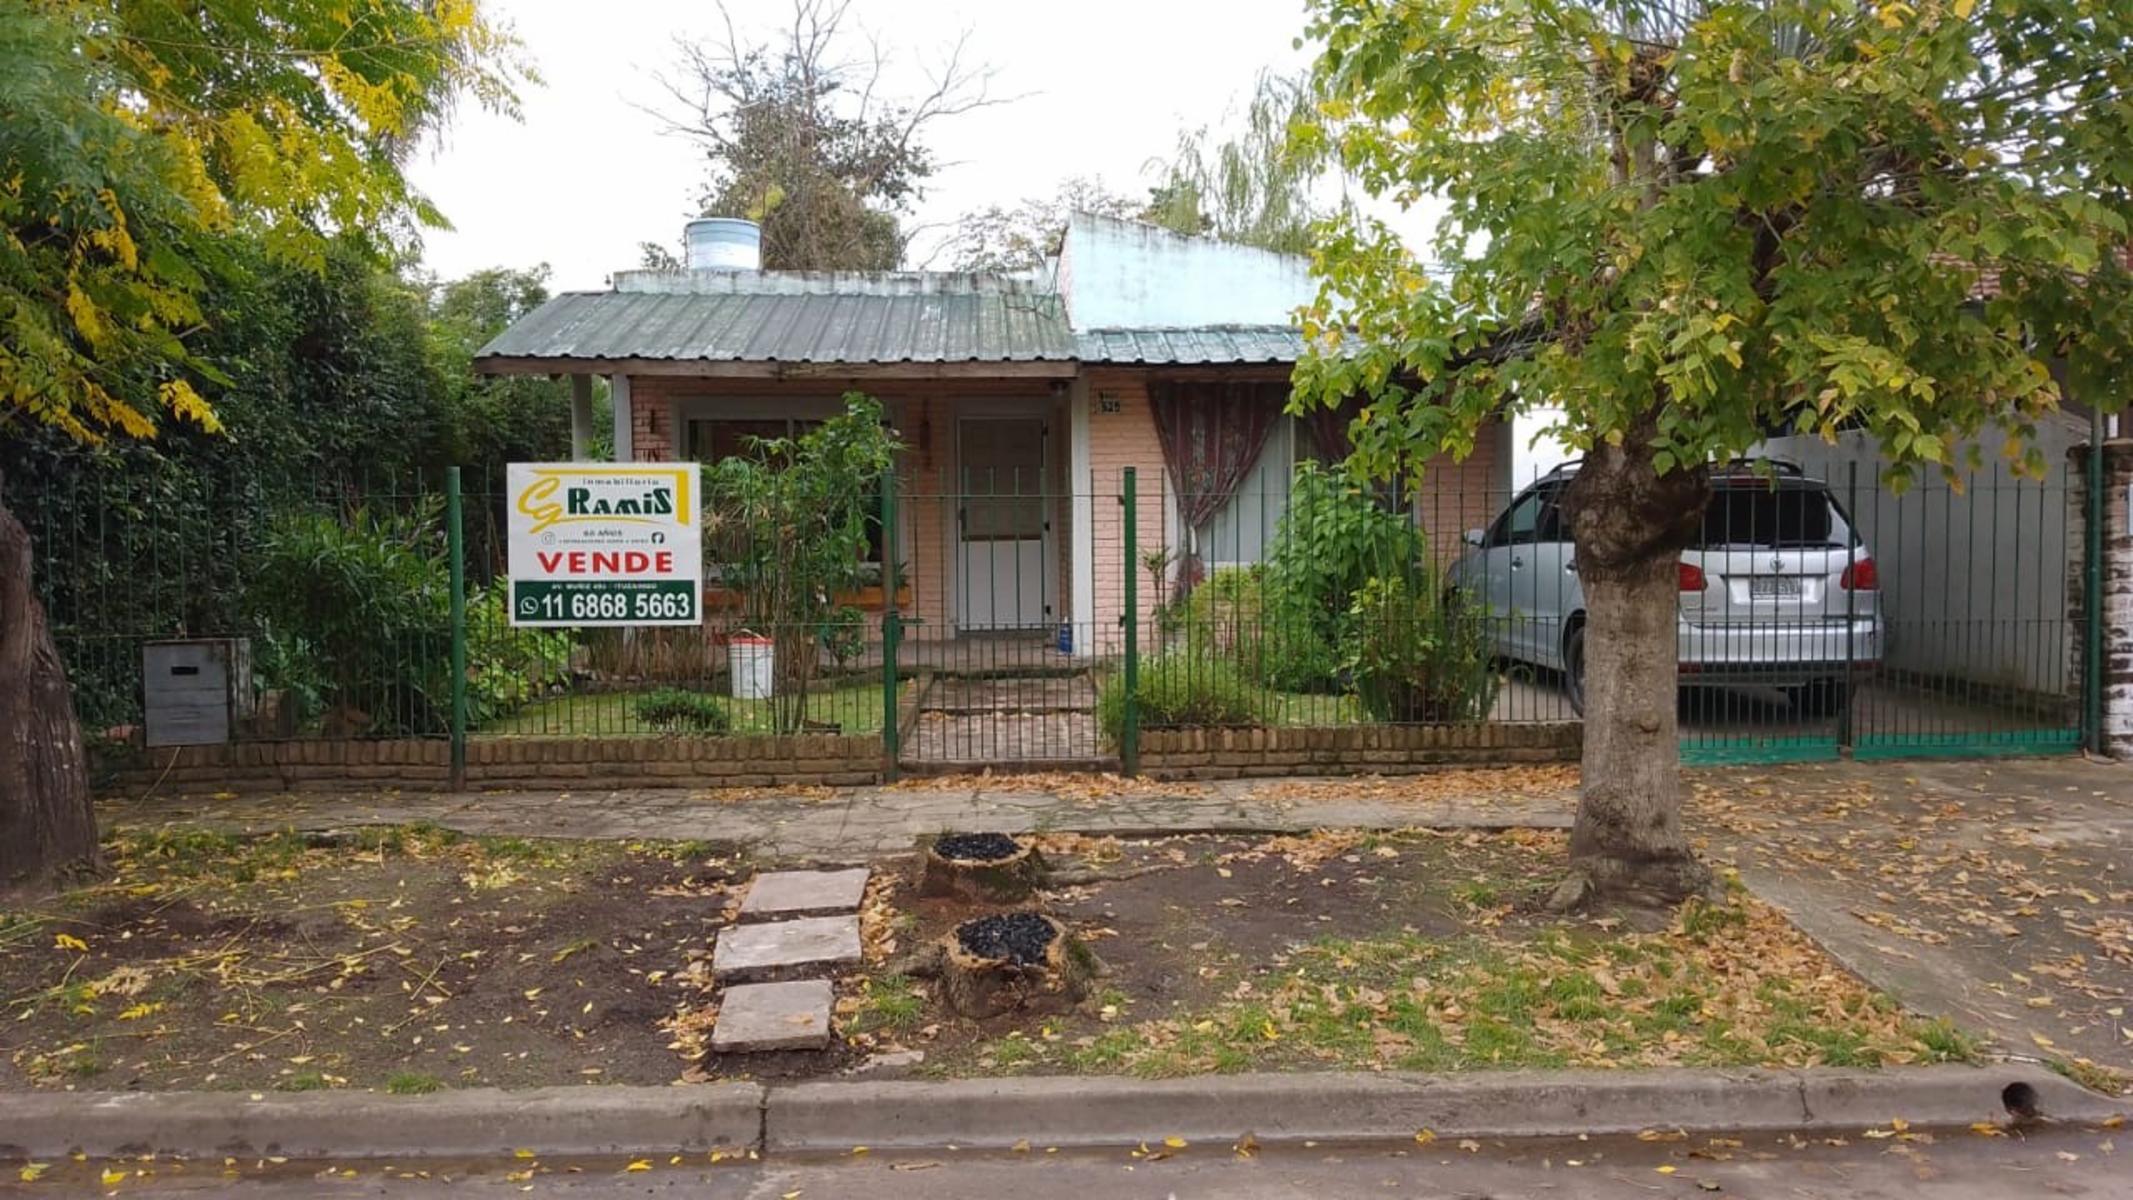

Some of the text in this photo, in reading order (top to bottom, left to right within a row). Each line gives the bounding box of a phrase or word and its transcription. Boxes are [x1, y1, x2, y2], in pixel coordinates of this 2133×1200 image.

[536, 551, 673, 574] VENDE
[541, 592, 690, 618] 11 6868 5663
